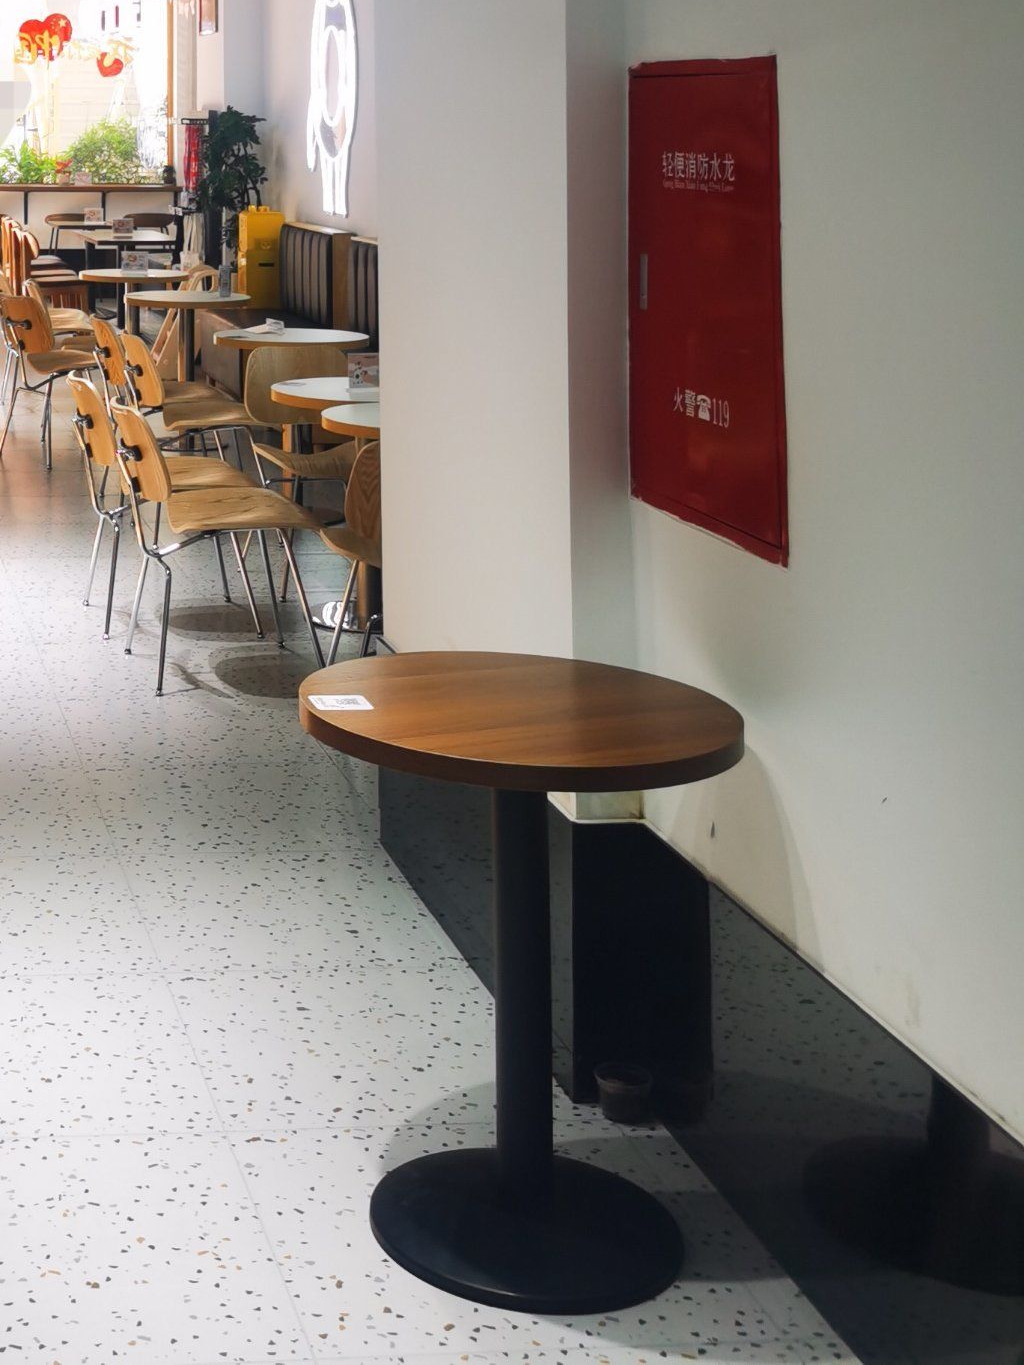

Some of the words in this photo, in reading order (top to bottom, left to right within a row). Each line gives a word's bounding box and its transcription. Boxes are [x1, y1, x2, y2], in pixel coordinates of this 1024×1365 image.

[662, 151, 735, 181] 轻便消防水龙
[673, 386, 696, 418] 火警
[712, 398, 730, 429] 119
